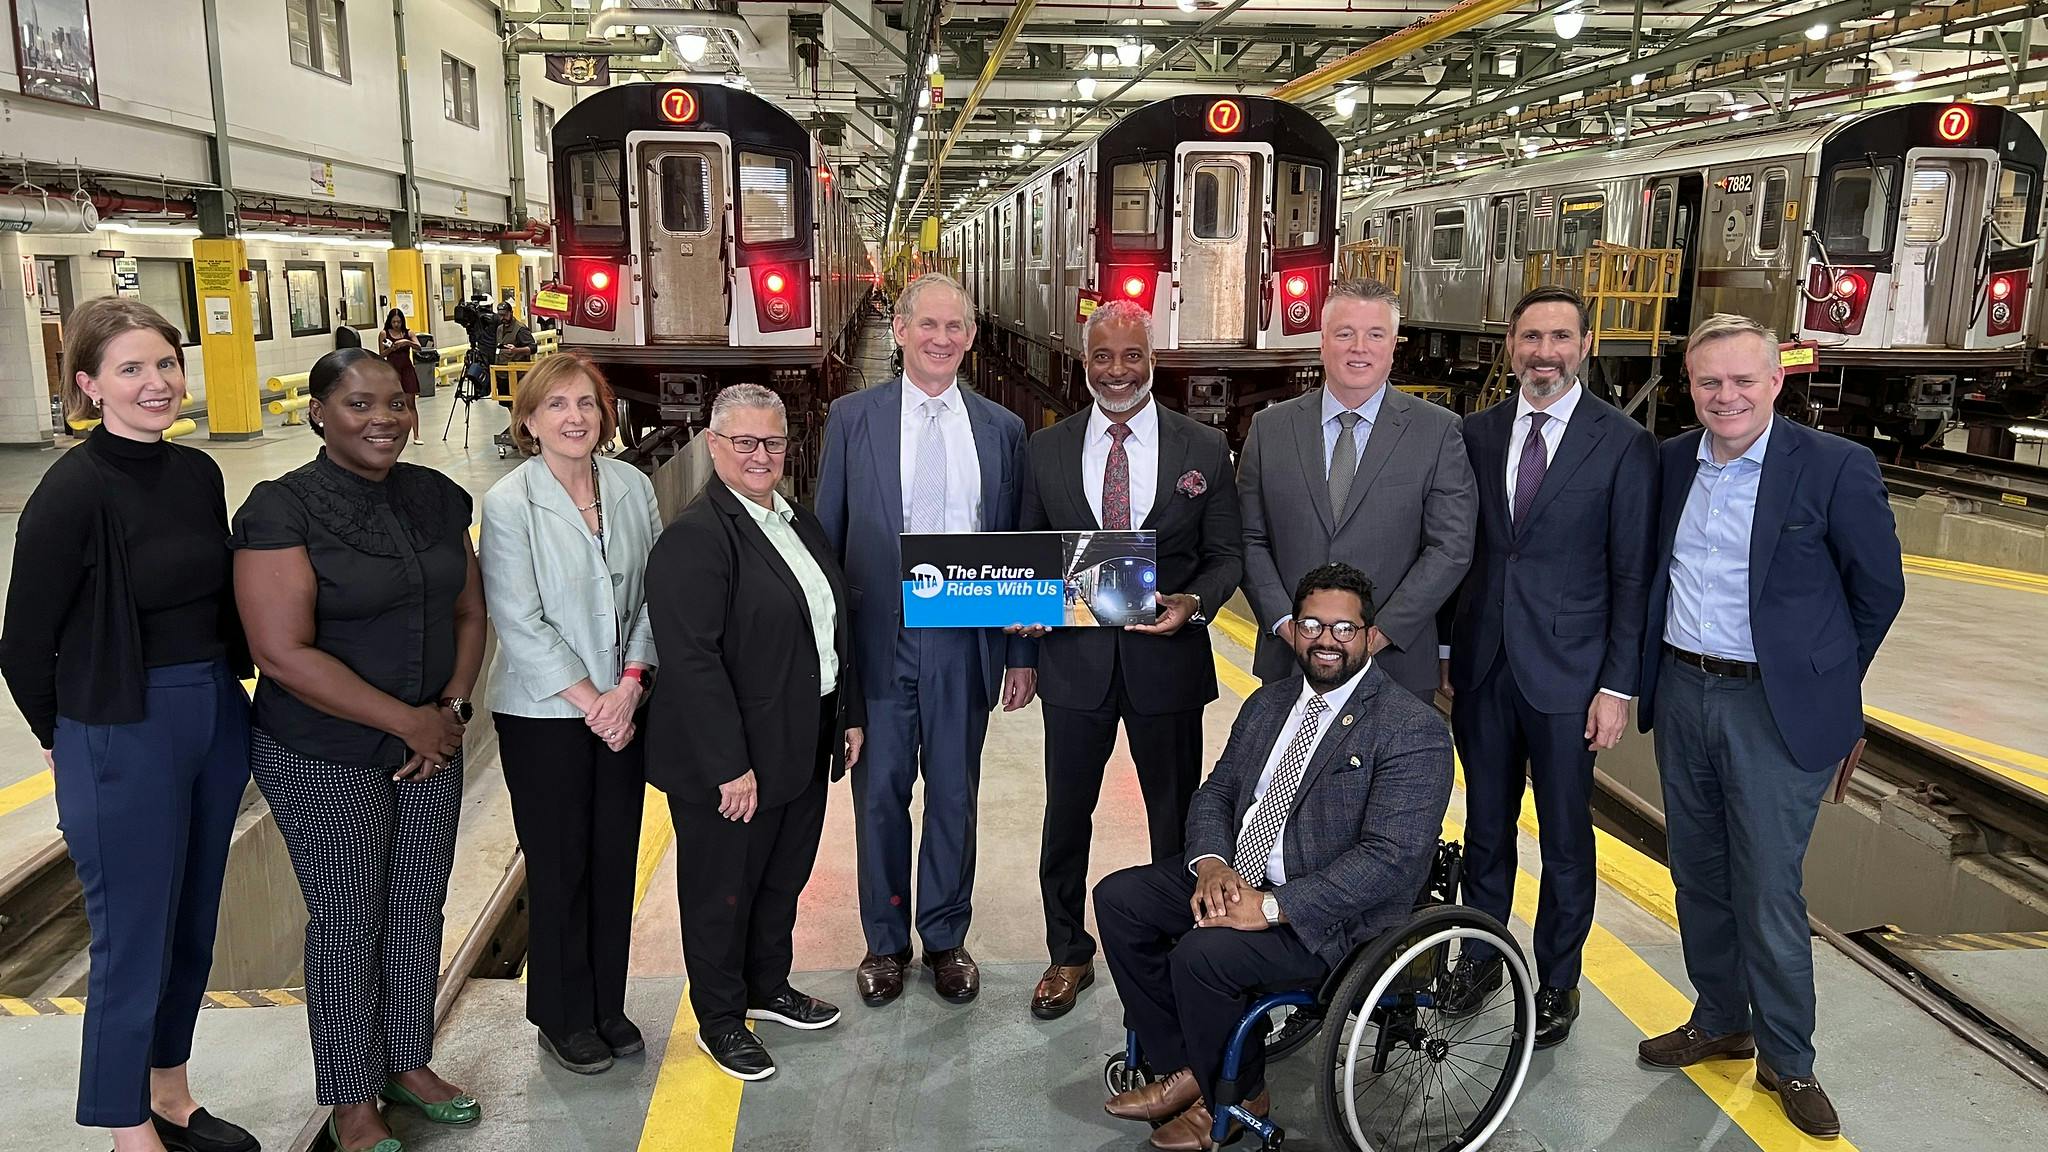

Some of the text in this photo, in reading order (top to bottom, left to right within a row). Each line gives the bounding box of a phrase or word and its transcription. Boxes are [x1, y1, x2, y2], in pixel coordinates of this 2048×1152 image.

[671, 95, 684, 116] 7
[1219, 106, 1231, 127] 7
[1949, 114, 1961, 134] 7
[1727, 174, 1752, 193] 7882
[910, 570, 939, 591] MTA
[946, 564, 1035, 580] The Future
[946, 580, 1057, 596] Rides With Us
